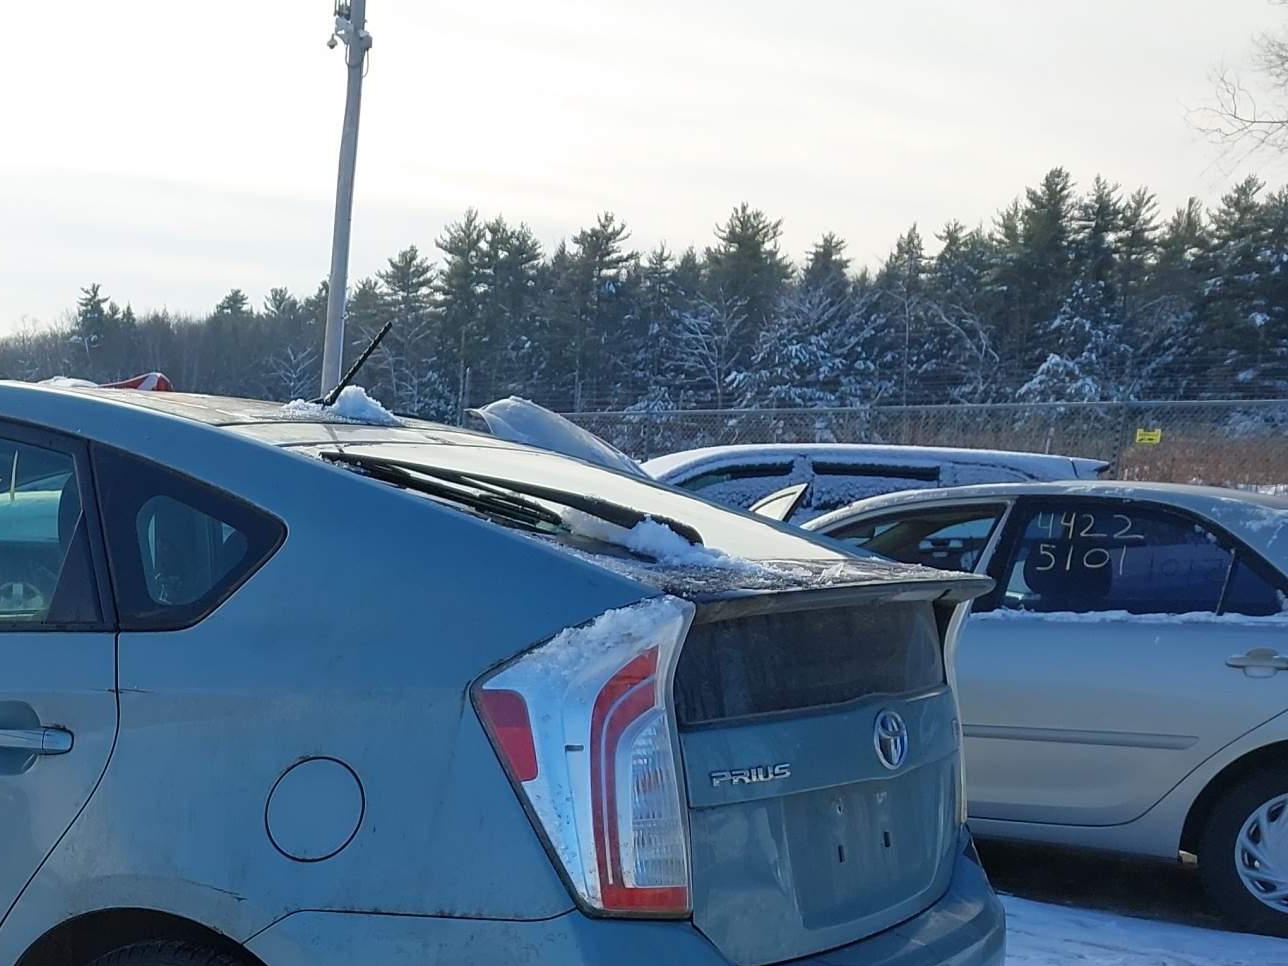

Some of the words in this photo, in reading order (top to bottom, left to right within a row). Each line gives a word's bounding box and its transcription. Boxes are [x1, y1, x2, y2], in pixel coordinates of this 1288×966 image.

[1037, 511, 1145, 540] 4422
[1035, 543, 1128, 576] 5101
[710, 762, 792, 787] PRIUS
